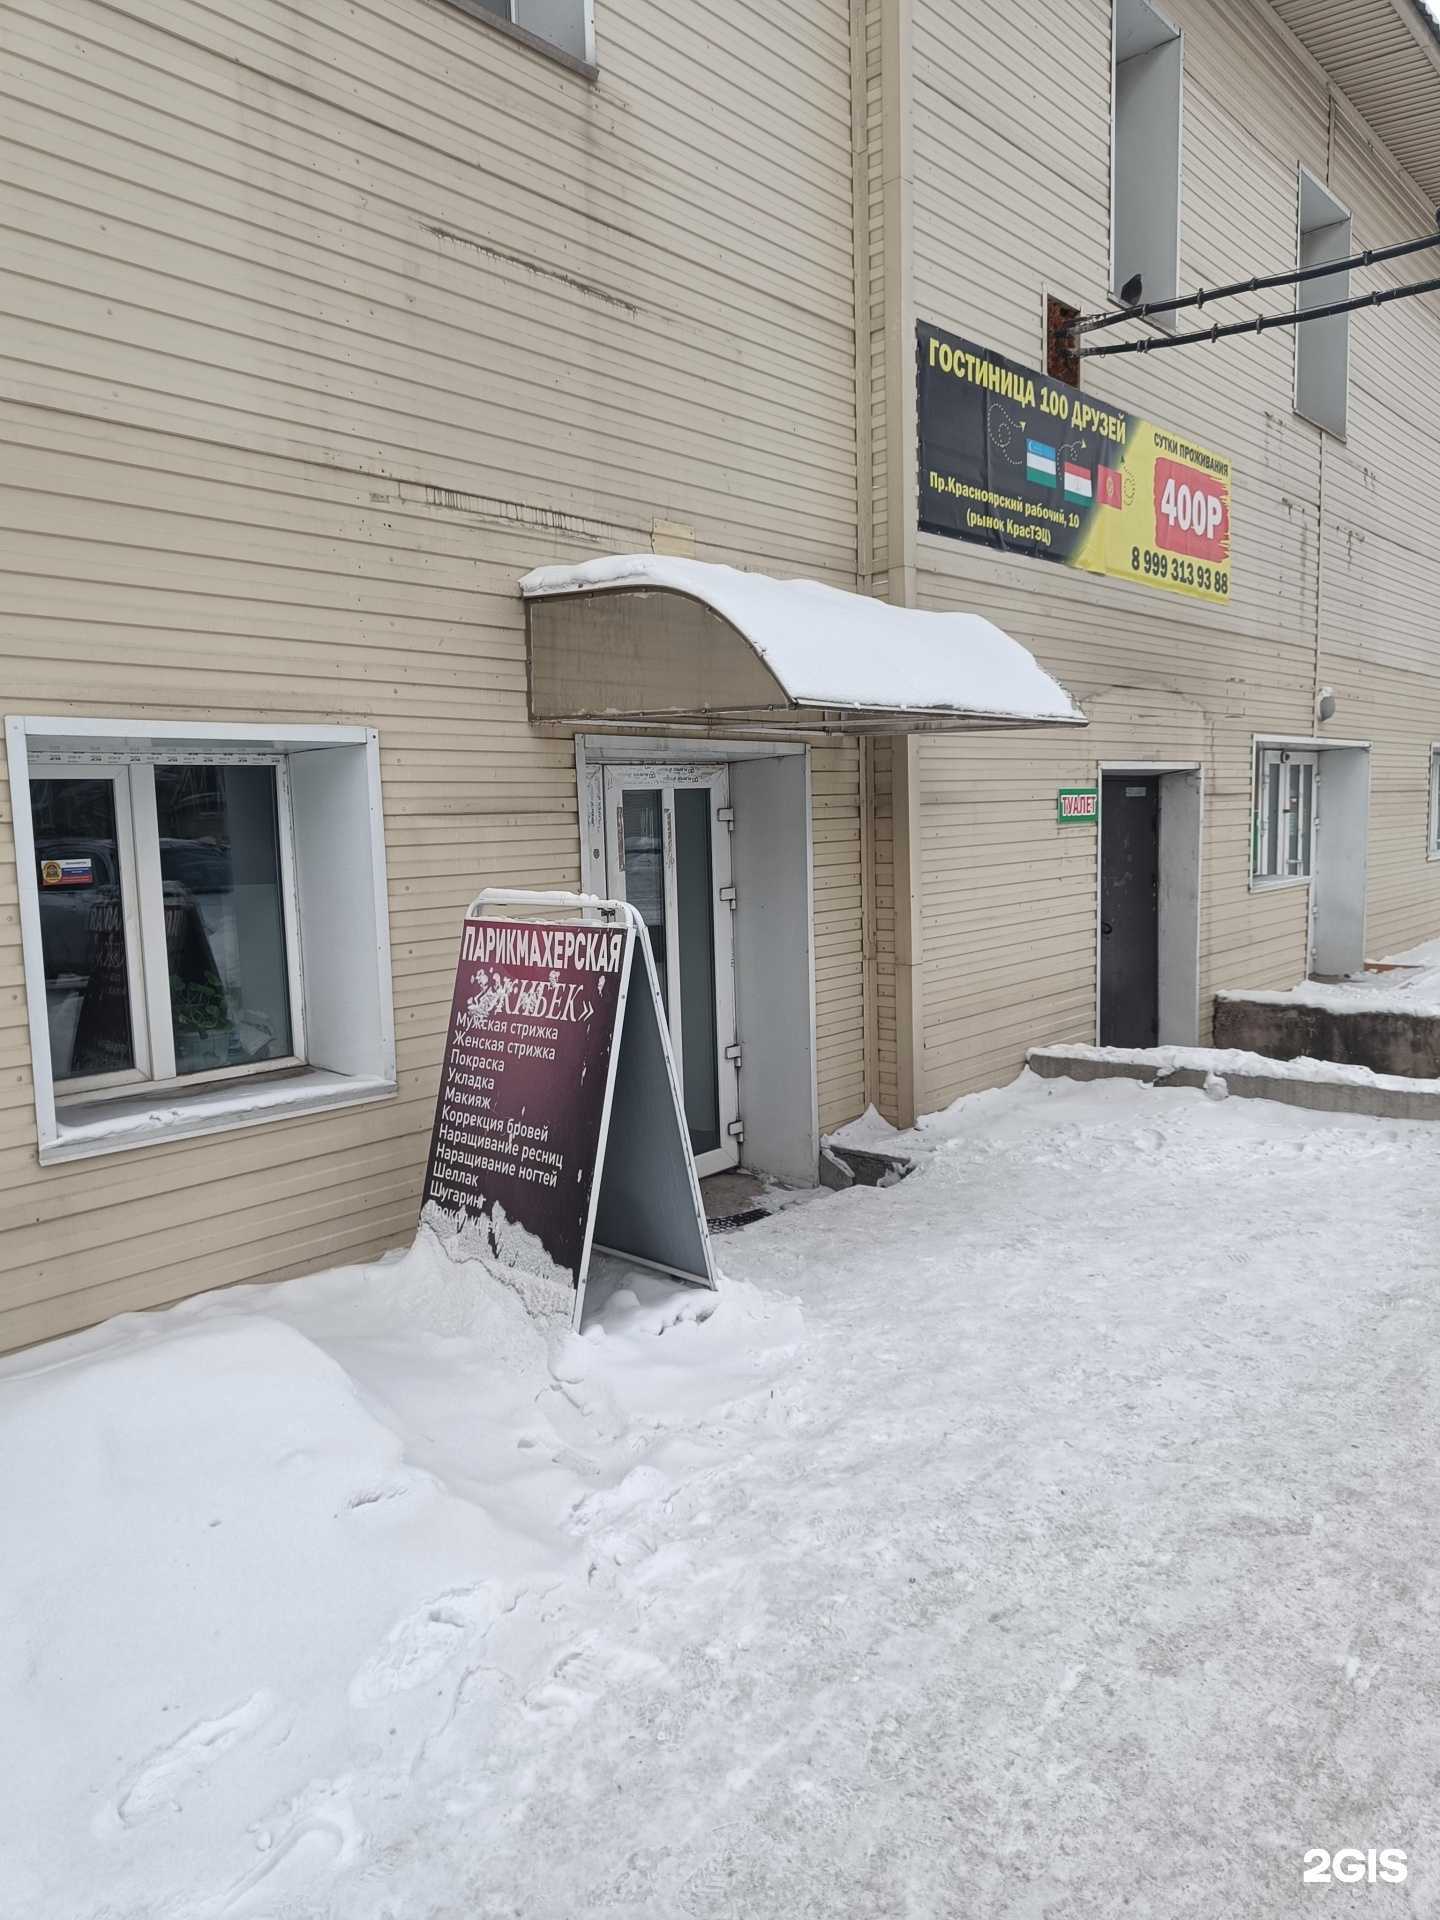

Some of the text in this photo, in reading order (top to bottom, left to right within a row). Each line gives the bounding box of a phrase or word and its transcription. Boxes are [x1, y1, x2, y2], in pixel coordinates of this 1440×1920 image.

[929, 337, 1127, 444] ГОСТИНИЦА 100 ДРУЗЕЙ
[1154, 432, 1229, 477] СУТКИ ПРОЖИВАНИЯ
[1025, 504, 1068, 529] рабочий,
[1068, 513, 1080, 529] 10
[1161, 478, 1223, 540] 400Р
[966, 508, 1052, 547] (рынок КрасТЭЦ)
[1131, 547, 1229, 594] 8 999 313 93 88
[1061, 795, 1097, 816] ТУАЛЕТ
[462, 926, 623, 973] ПАРИКМАХЕРСКАЯ
[456, 1011, 559, 1040] Мужская стрижка
[450, 1049, 505, 1072] Покраска
[452, 1030, 556, 1060] Женская стрижка
[447, 1067, 495, 1090] Укладка
[444, 1086, 491, 1109] Макияж
[441, 1105, 549, 1142] Коррекция бровей
[439, 1123, 563, 1170] Наращивание ресниц
[433, 1161, 479, 1187] Шеллак
[436, 1142, 558, 1188] Наращивание ногтей
[430, 1180, 486, 1209] Шугаринг
